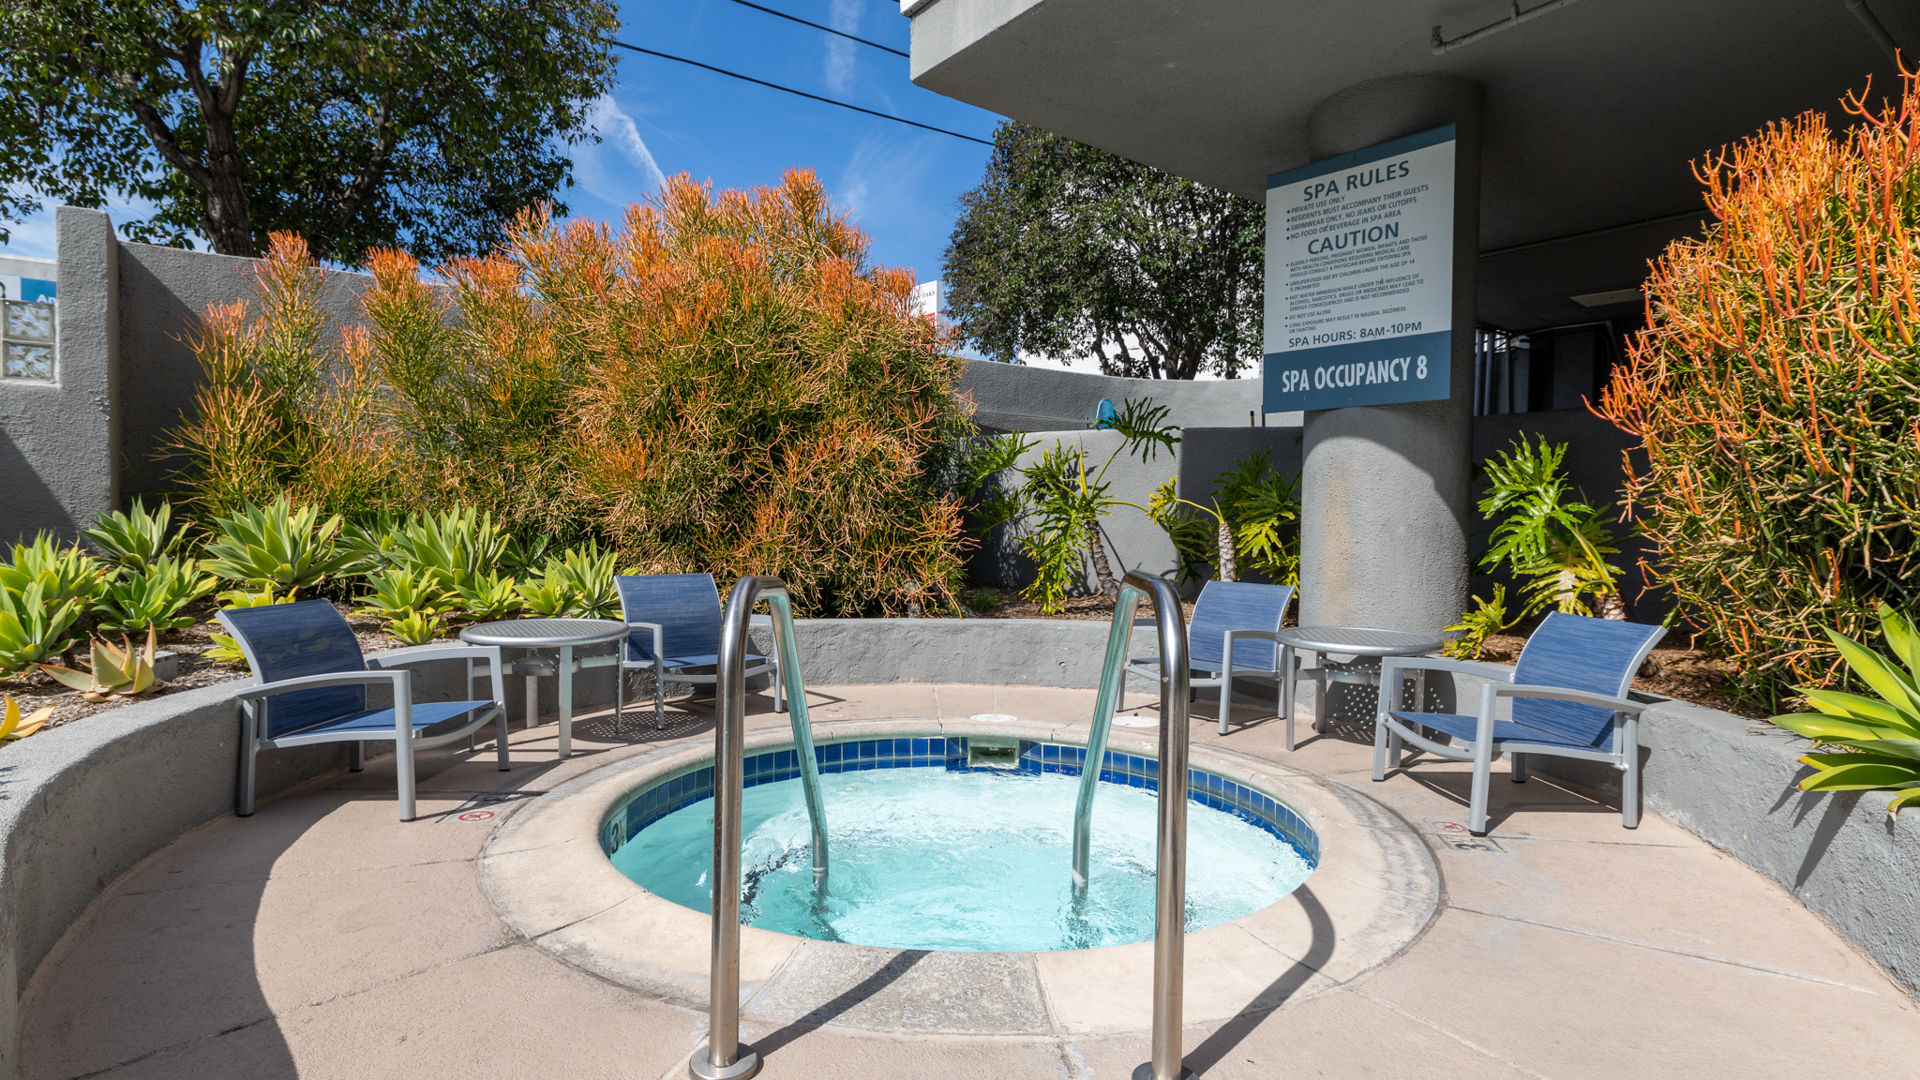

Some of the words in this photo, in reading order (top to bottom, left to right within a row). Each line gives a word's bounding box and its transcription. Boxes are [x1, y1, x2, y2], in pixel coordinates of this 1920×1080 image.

[1304, 180, 1340, 202] SPA
[1346, 160, 1410, 191] RULES
[1291, 210, 1321, 222] RESIDENTS
[1323, 206, 1340, 215] MUST
[1341, 196, 1382, 210] ACCOMPANY
[1384, 191, 1402, 200] THEIR
[1403, 184, 1429, 196] GUESTS
[1291, 203, 1314, 214] PRIVATE
[1329, 196, 1345, 205] ONLY
[1291, 219, 1324, 231] SWIMWEAR
[1357, 206, 1376, 216] JEANS
[1388, 197, 1417, 208] CUTOFFS
[1301, 229, 1317, 237] FOOD
[1329, 219, 1360, 231] BEVERAGE
[1384, 210, 1401, 218] AREA
[1308, 222, 1399, 254] CAUTION
[1289, 337, 1309, 348] SPA
[1313, 330, 1356, 344] HOURS:
[1360, 322, 1422, 338] 8AM-10PM
[1282, 369, 1310, 393] SPA
[1314, 357, 1411, 390] OCCUPANCY
[1416, 355, 1427, 379] 8
